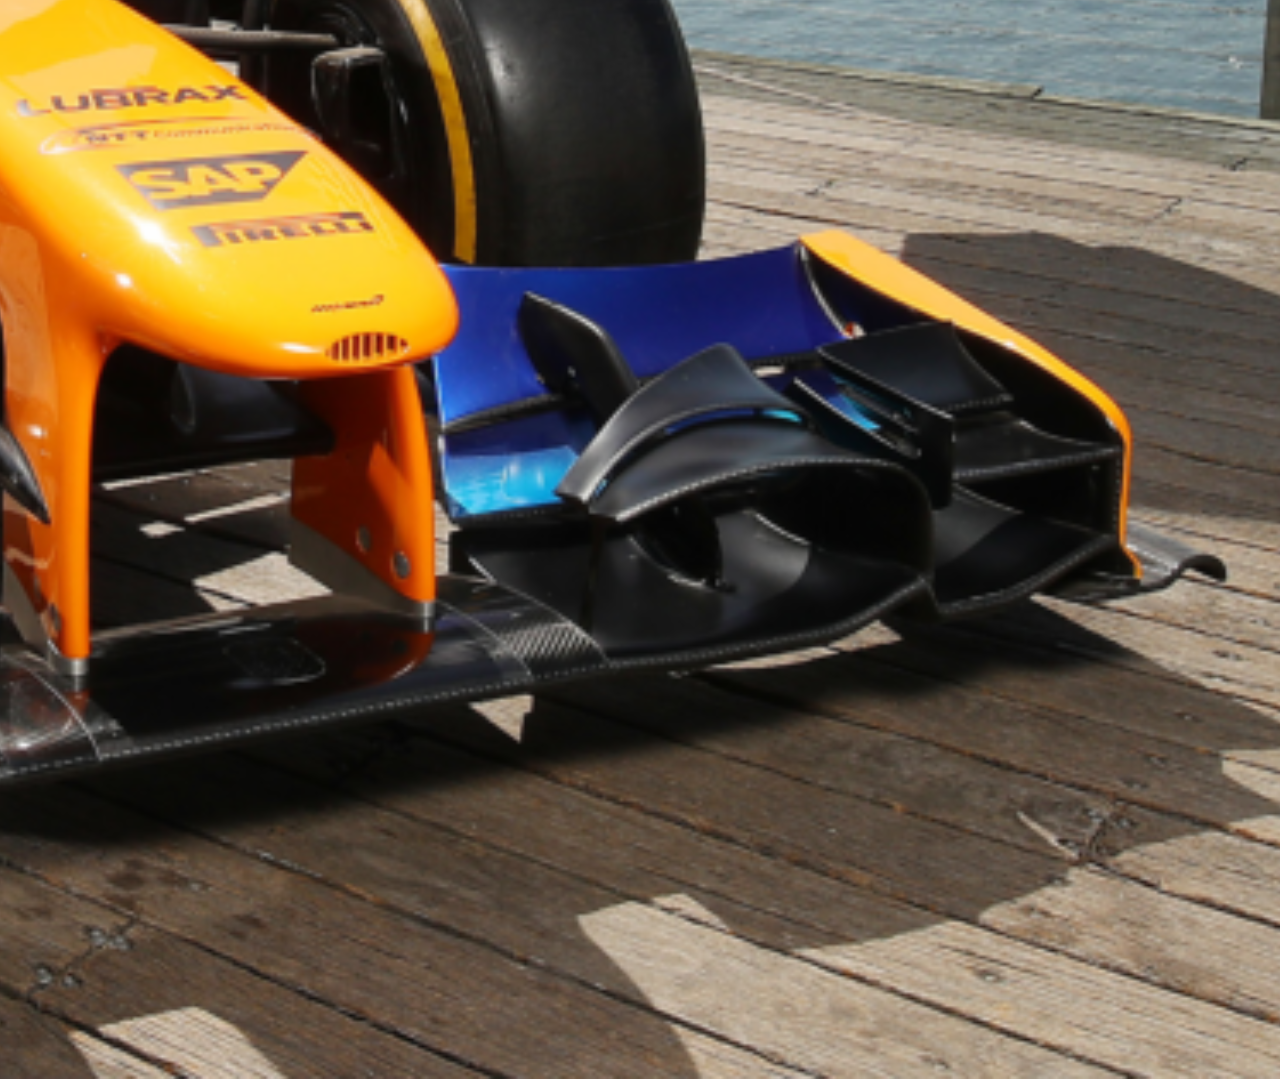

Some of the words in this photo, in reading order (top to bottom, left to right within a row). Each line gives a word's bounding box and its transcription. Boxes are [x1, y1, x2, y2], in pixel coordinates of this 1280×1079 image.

[16, 84, 247, 118] LUBRAX
[128, 161, 283, 201] SAP
[191, 212, 373, 247] PIRELLI
